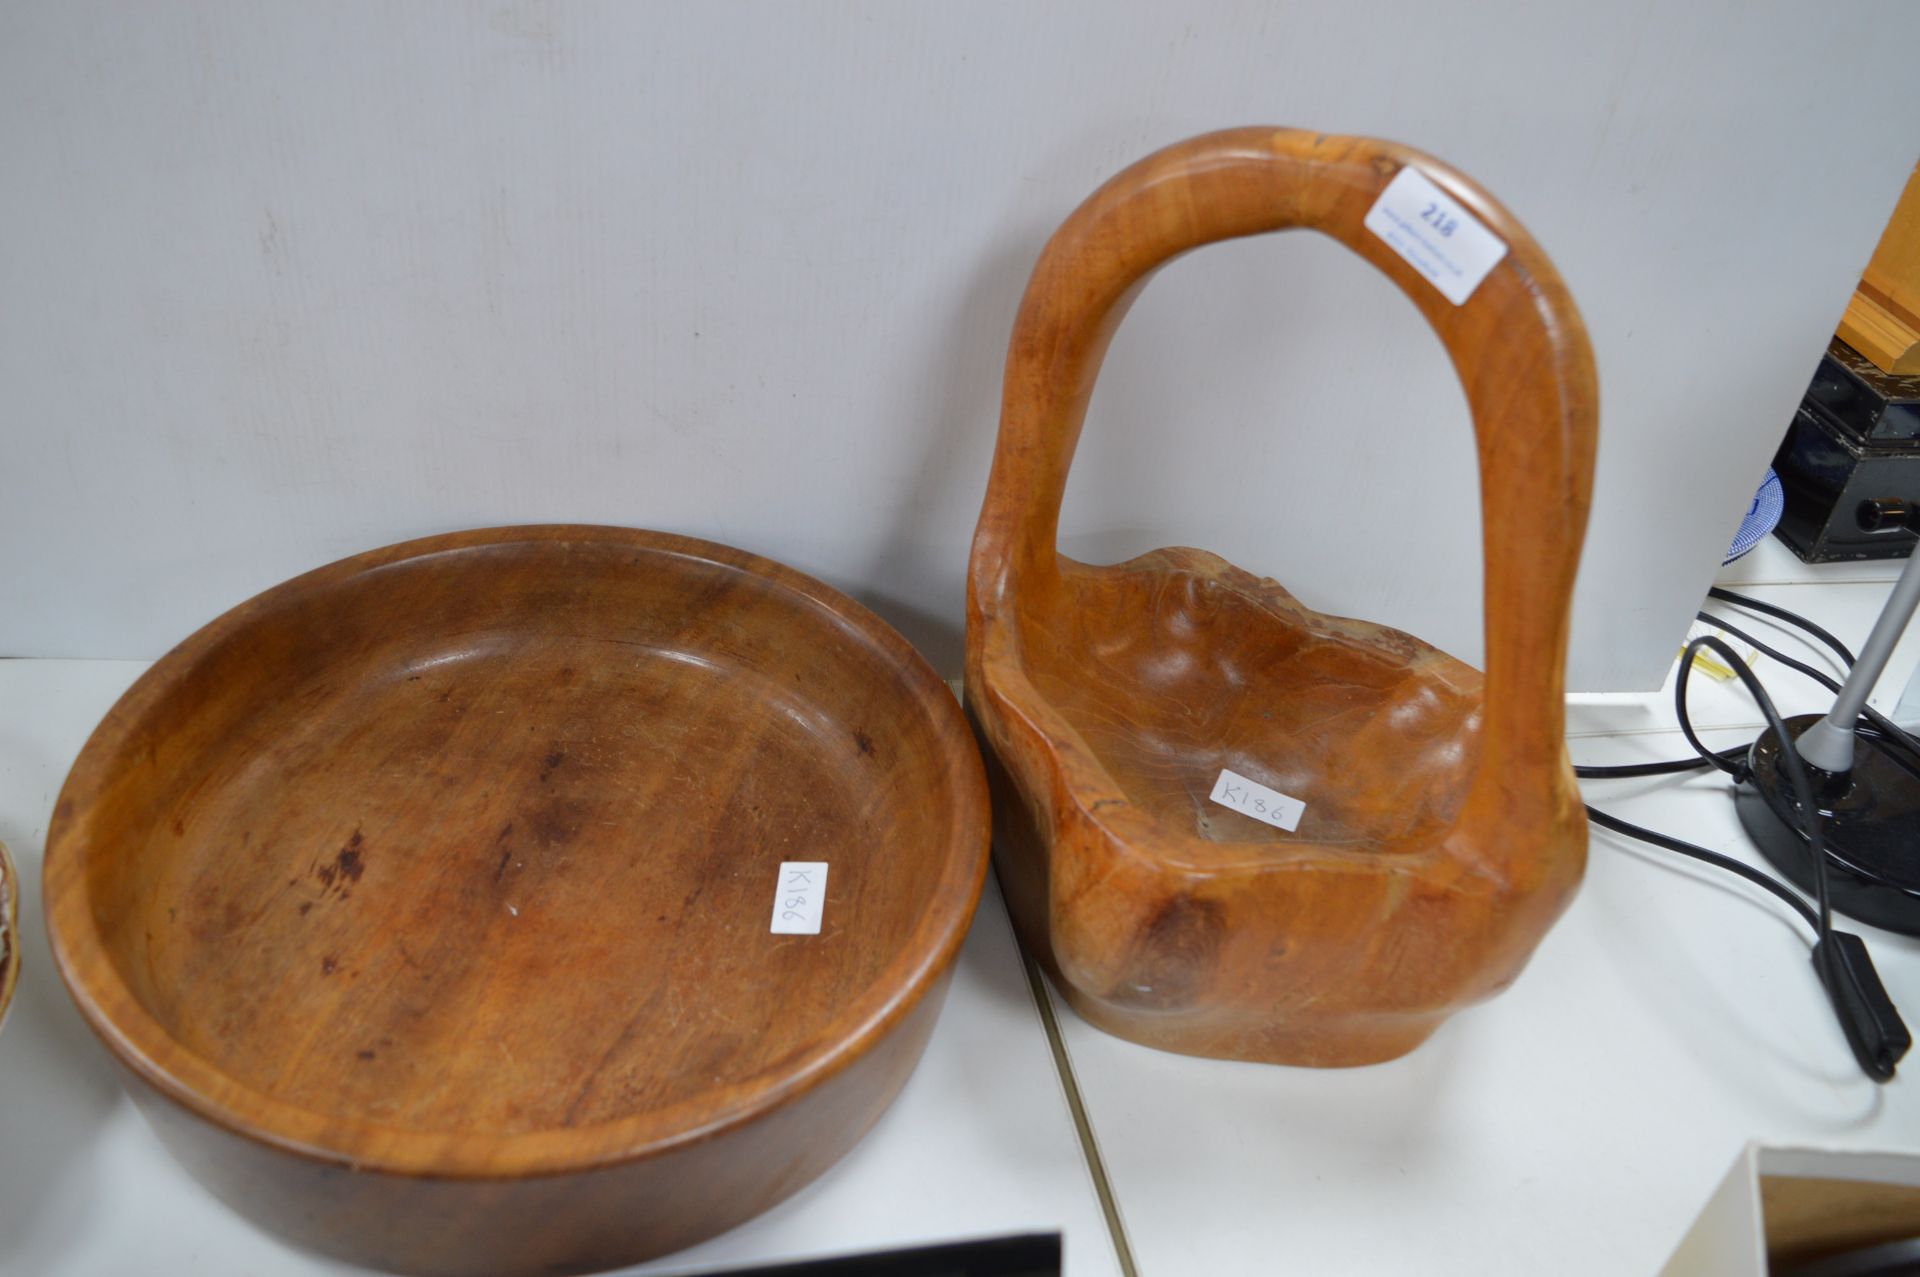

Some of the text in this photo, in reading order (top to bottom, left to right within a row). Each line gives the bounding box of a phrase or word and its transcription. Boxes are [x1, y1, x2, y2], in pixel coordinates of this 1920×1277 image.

[1421, 202, 1459, 238] 218
[1222, 781, 1285, 820] K186
[781, 869, 812, 920] K186
